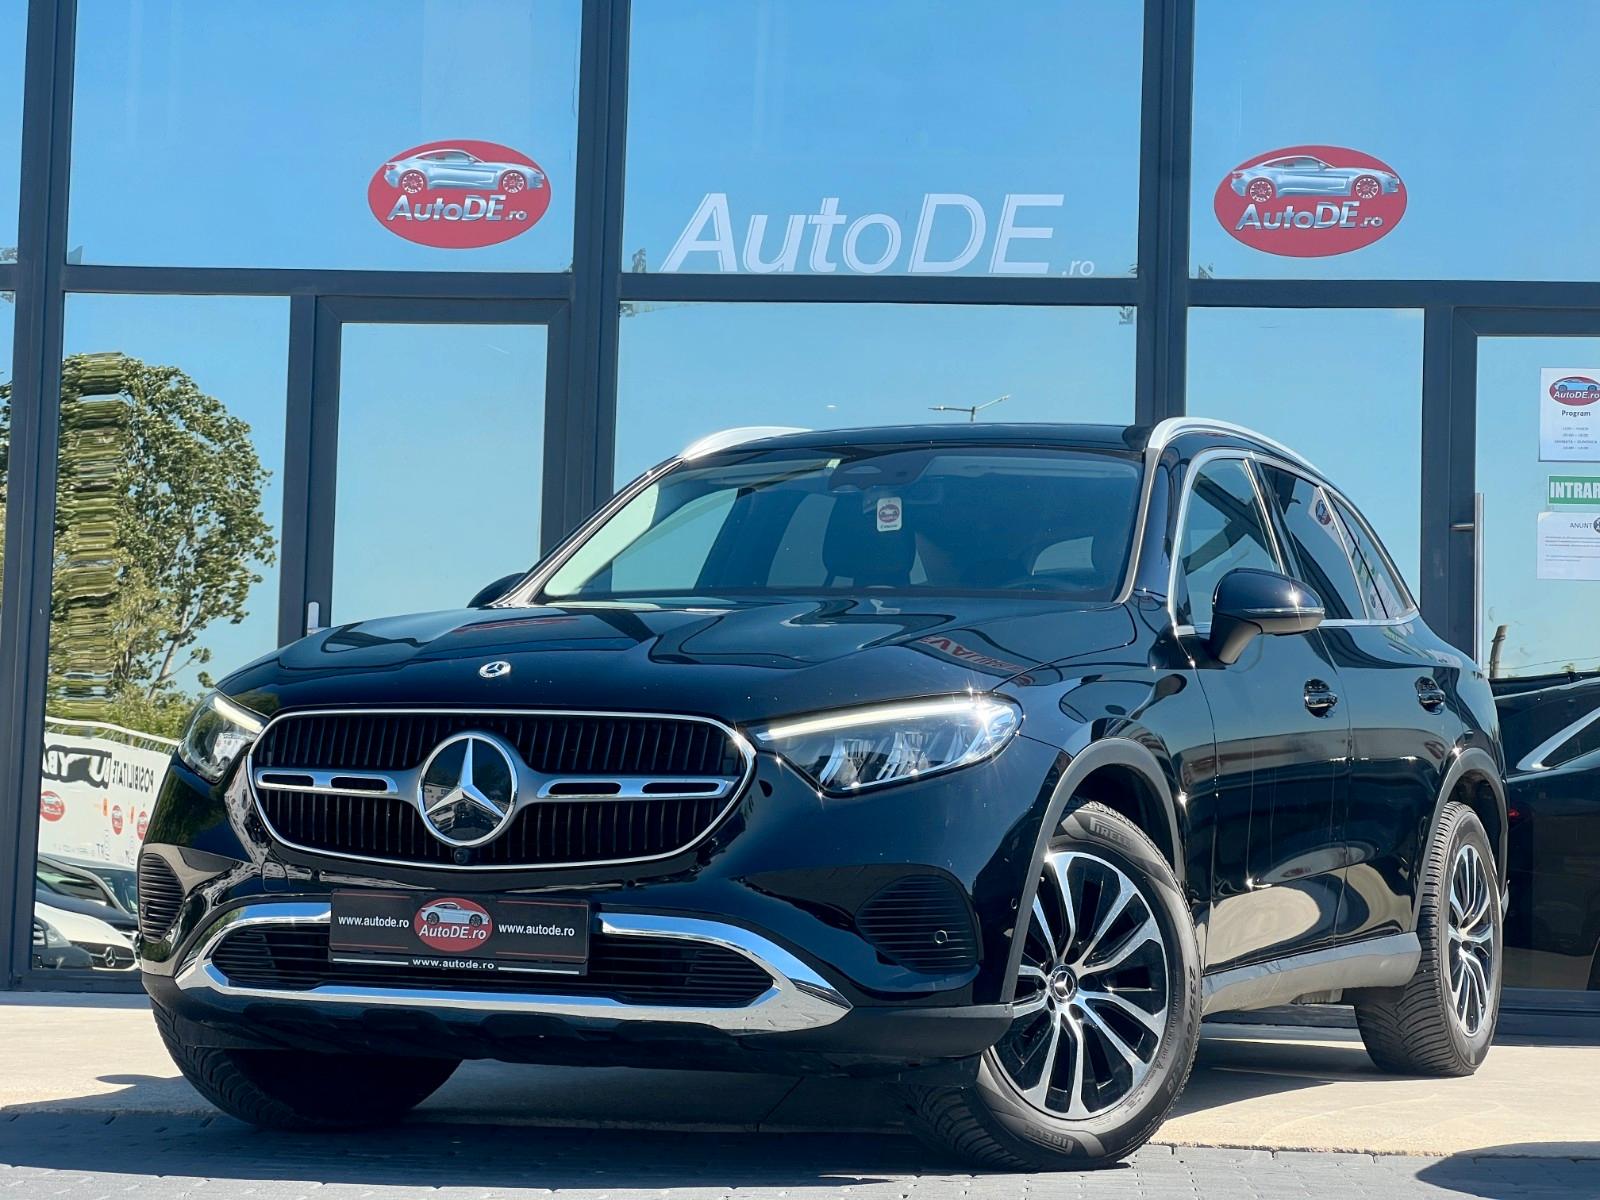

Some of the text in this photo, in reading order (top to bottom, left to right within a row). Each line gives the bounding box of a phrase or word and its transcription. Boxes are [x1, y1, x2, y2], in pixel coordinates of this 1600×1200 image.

[338, 916, 410, 928] www.autode.ro
[418, 924, 487, 940] AutoDE.ro
[498, 924, 575, 937] www.autode.ro
[412, 959, 495, 970] www.autode.ro
